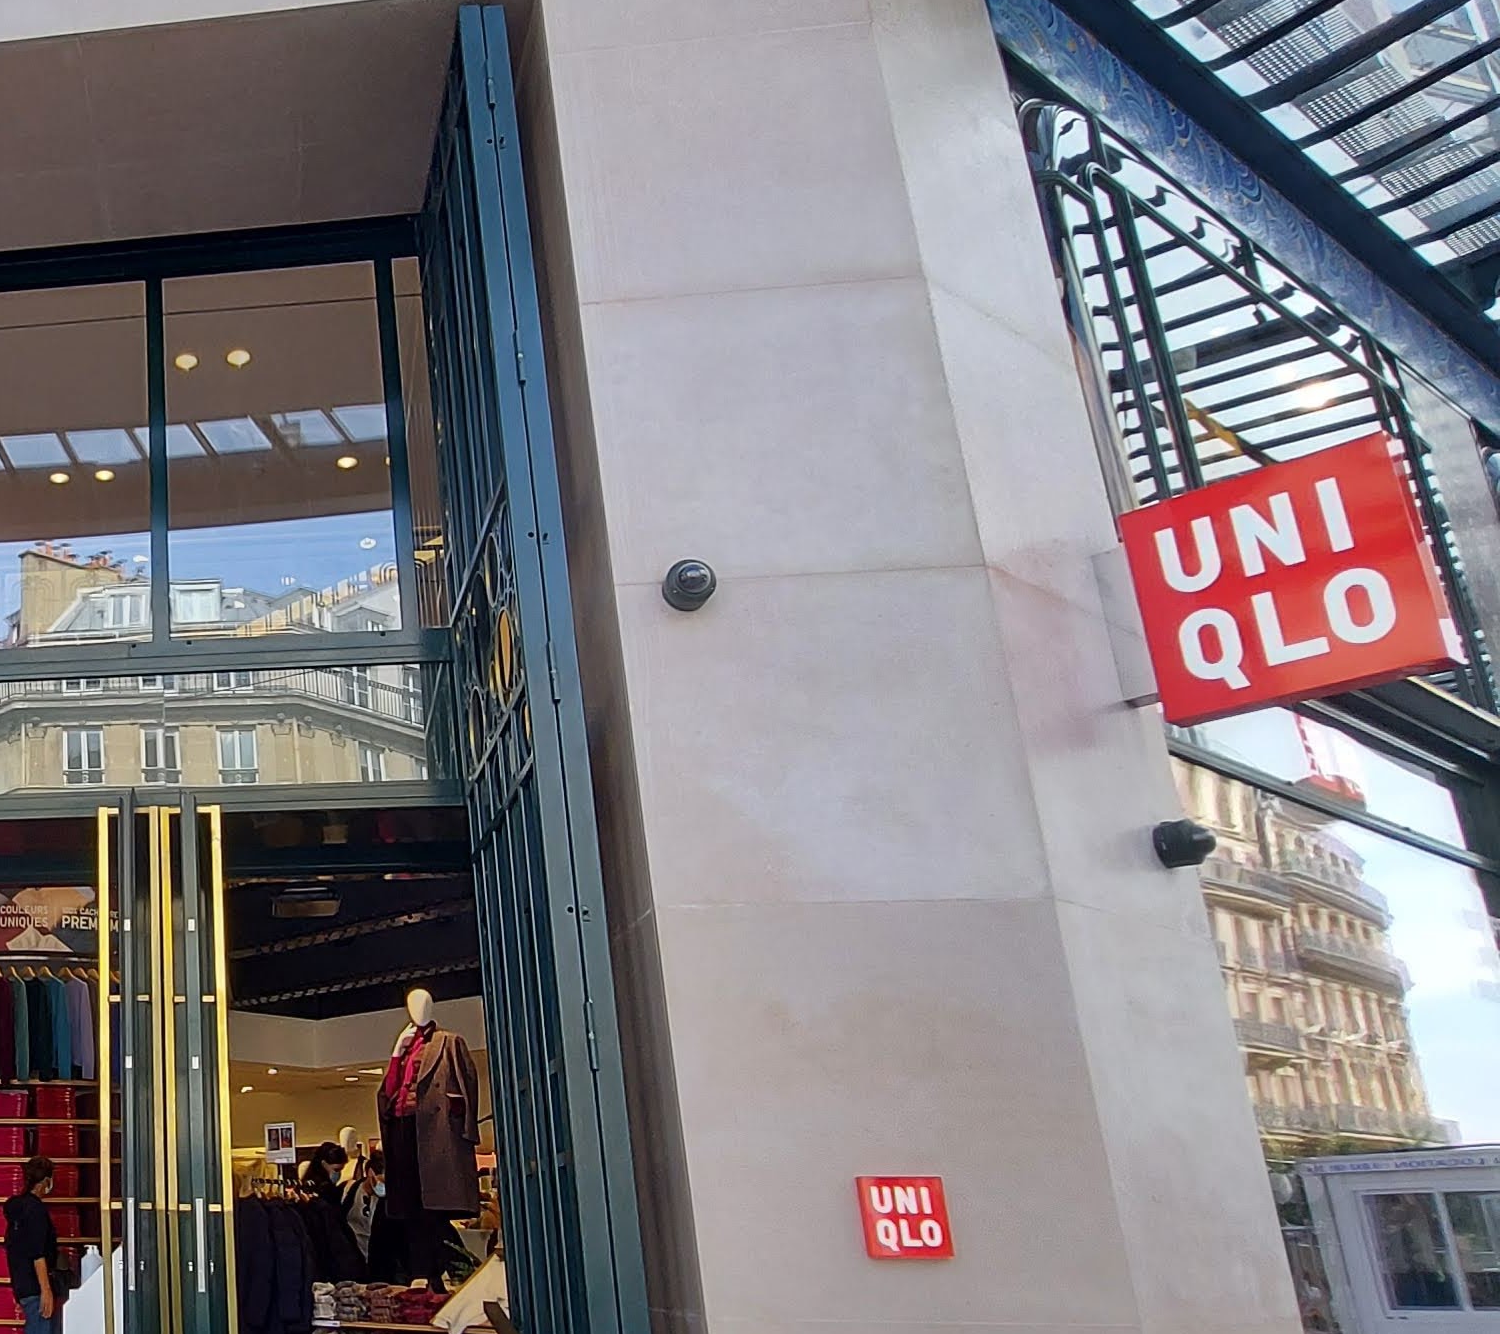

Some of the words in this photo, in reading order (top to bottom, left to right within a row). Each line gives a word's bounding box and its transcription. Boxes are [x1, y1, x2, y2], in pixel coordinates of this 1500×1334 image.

[1153, 476, 1355, 593] UNI
[1178, 567, 1397, 690] QLO
[0, 905, 49, 915] COULEURS
[0, 916, 49, 929] UNIQUES
[61, 915, 118, 932] PREMM
[870, 1186, 933, 1214] UNI
[876, 1218, 943, 1252] QLO
